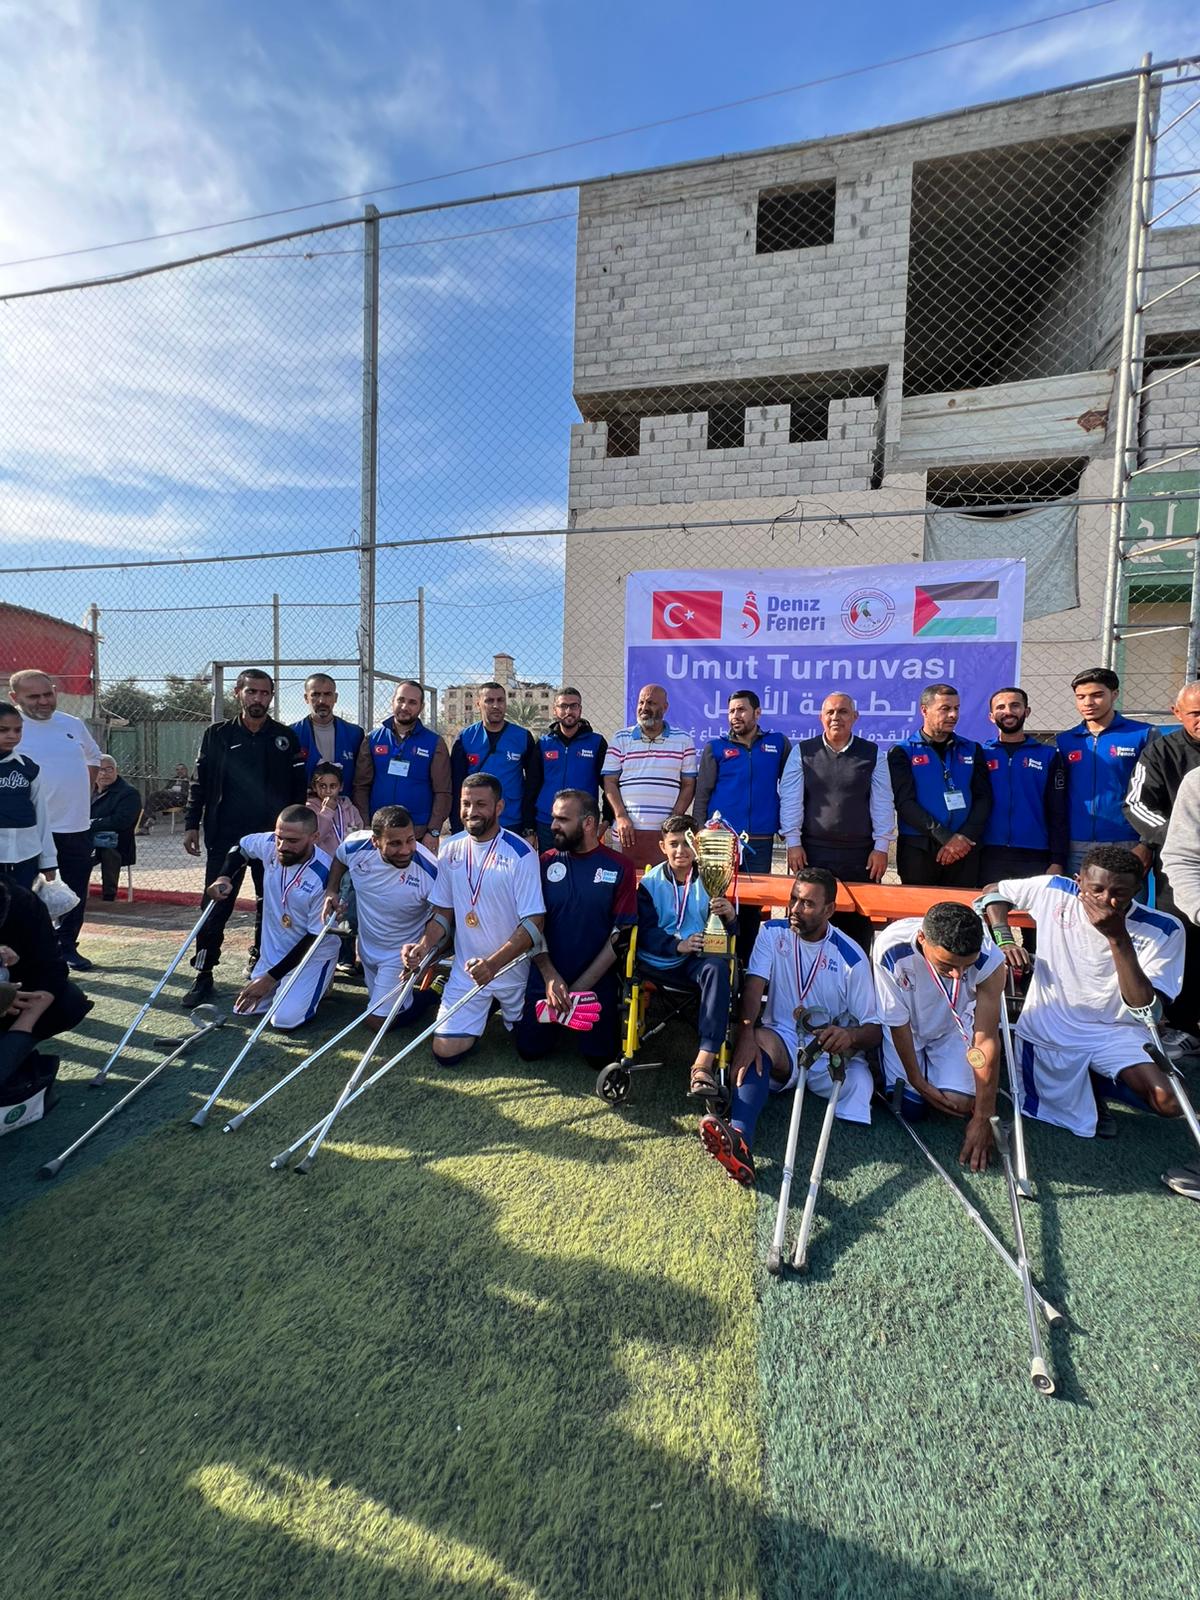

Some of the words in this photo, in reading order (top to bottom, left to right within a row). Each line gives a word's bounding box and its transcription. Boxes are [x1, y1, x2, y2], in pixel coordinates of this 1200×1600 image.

[768, 596, 820, 612] Deniz
[766, 613, 826, 632] Feneri
[666, 654, 759, 680] Umut
[766, 653, 956, 680] Turnuvası
[0, 770, 30, 789] arbie
